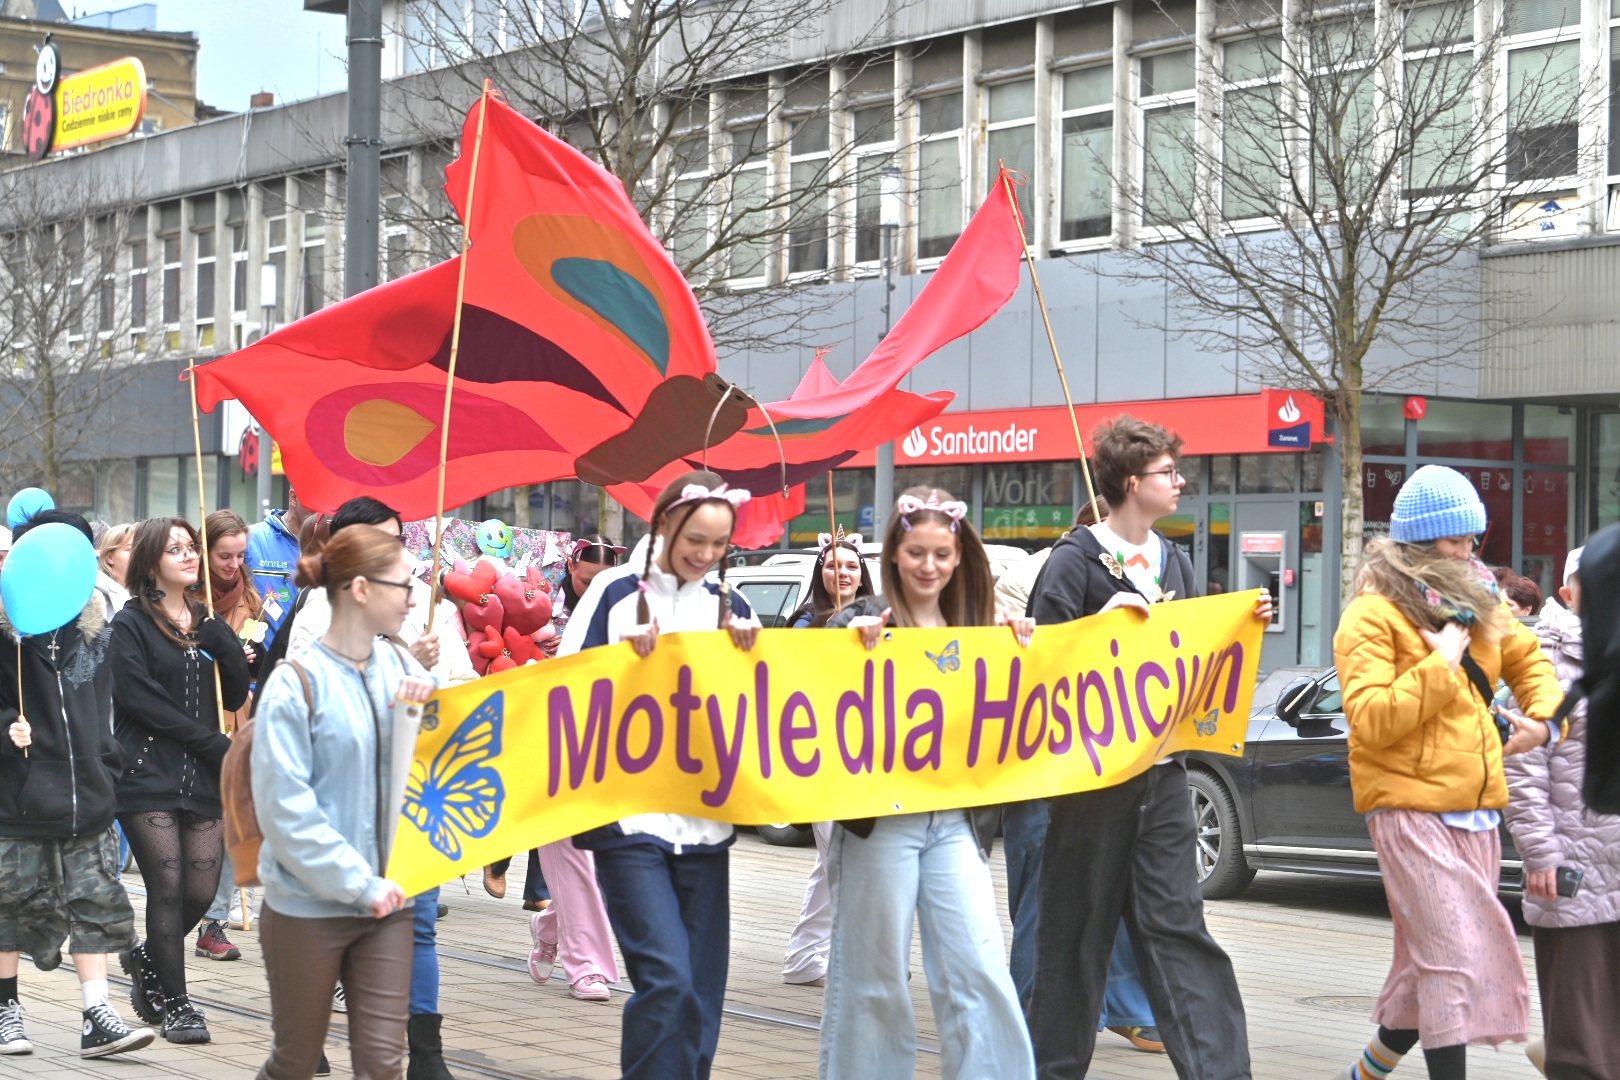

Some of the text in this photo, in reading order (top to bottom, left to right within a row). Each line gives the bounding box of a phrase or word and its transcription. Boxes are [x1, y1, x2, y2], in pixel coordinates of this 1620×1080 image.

[63, 77, 132, 115] Biedronka
[62, 107, 132, 132] Codziennie niskie ceny
[930, 423, 1038, 456] Santander
[984, 471, 1054, 505] Work
[1362, 520, 1392, 529] BANKOMA
[549, 662, 821, 806] Motyle
[836, 660, 944, 774] dla
